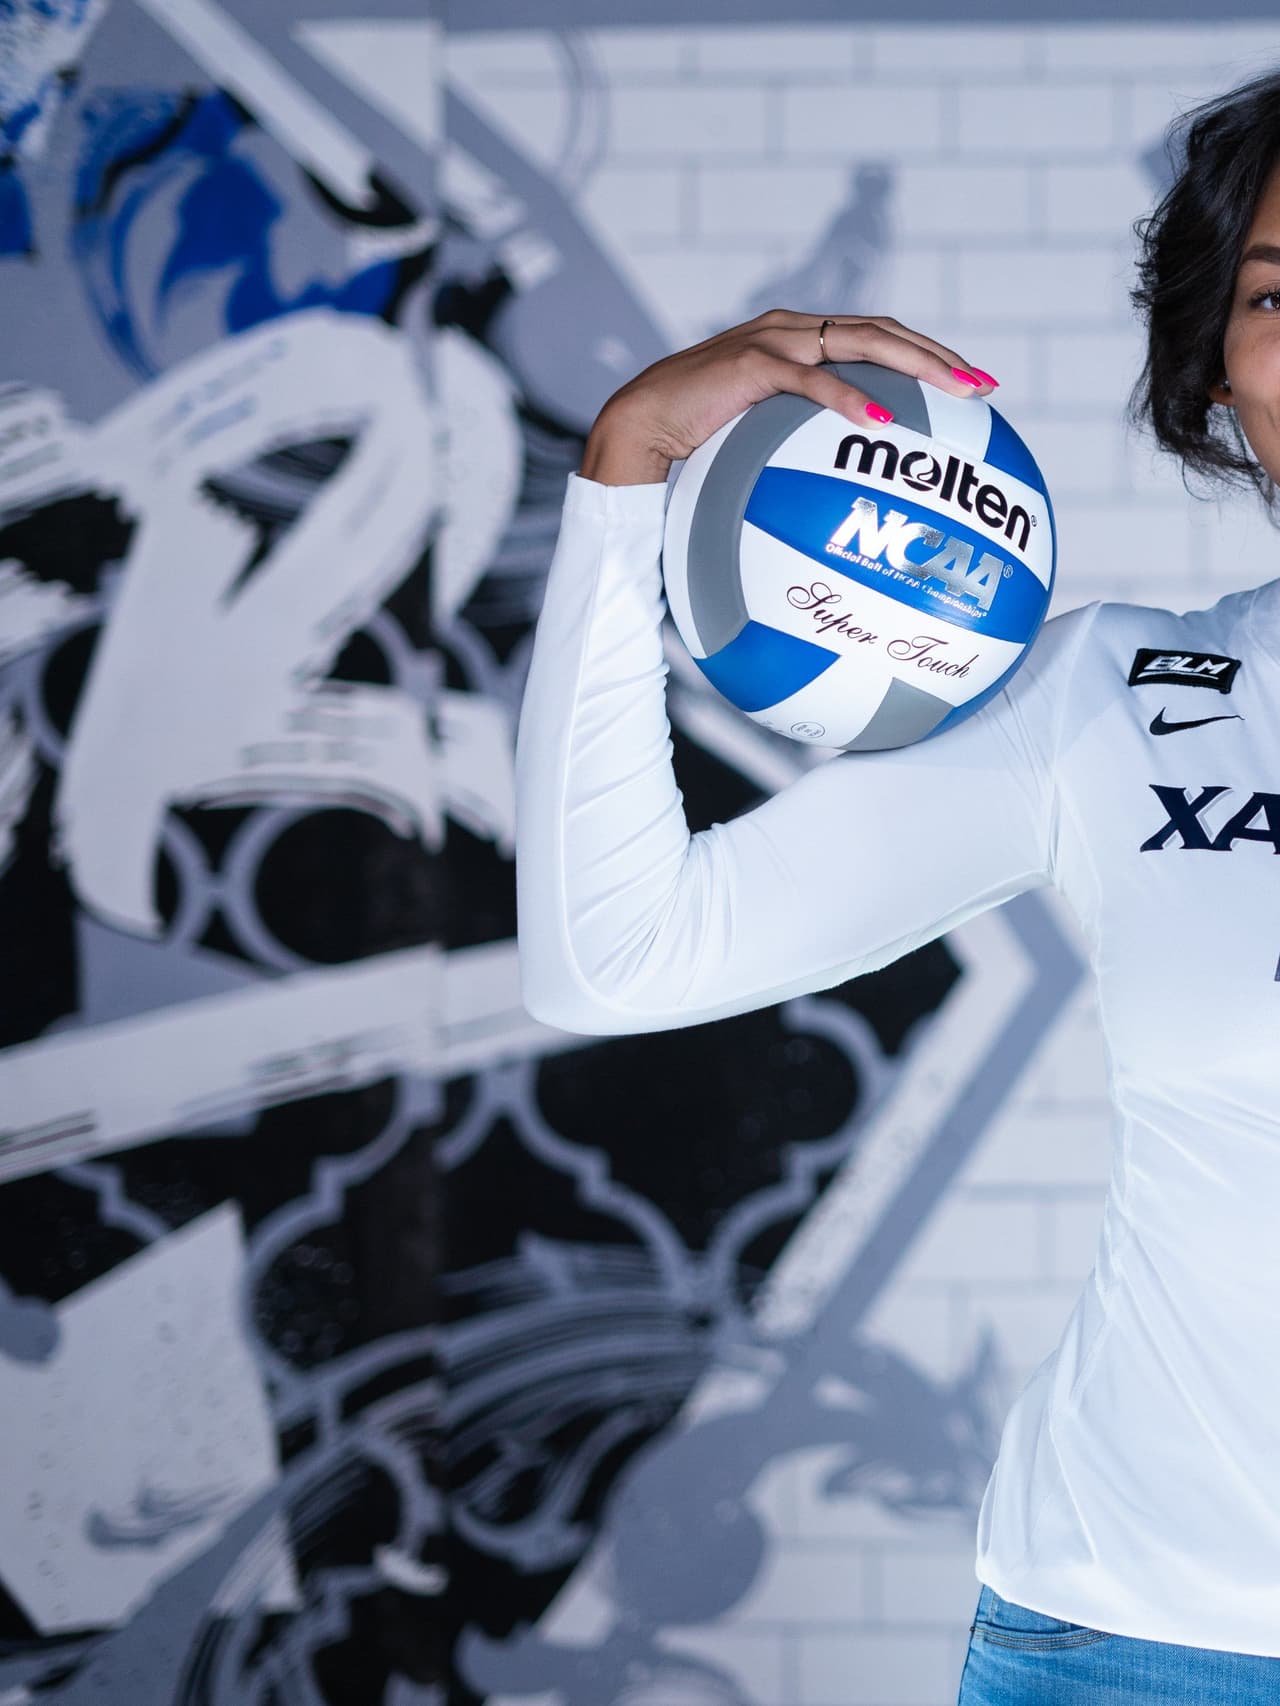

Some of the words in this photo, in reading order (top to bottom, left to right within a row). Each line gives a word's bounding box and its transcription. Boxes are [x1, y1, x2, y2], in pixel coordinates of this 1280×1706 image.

[834, 434, 1031, 552] molten
[825, 543, 861, 564] Official
[860, 557, 883, 573] Ball
[882, 568, 895, 578] of
[829, 497, 1004, 611] NCAA
[787, 582, 878, 644] Super
[887, 635, 980, 679] Touch
